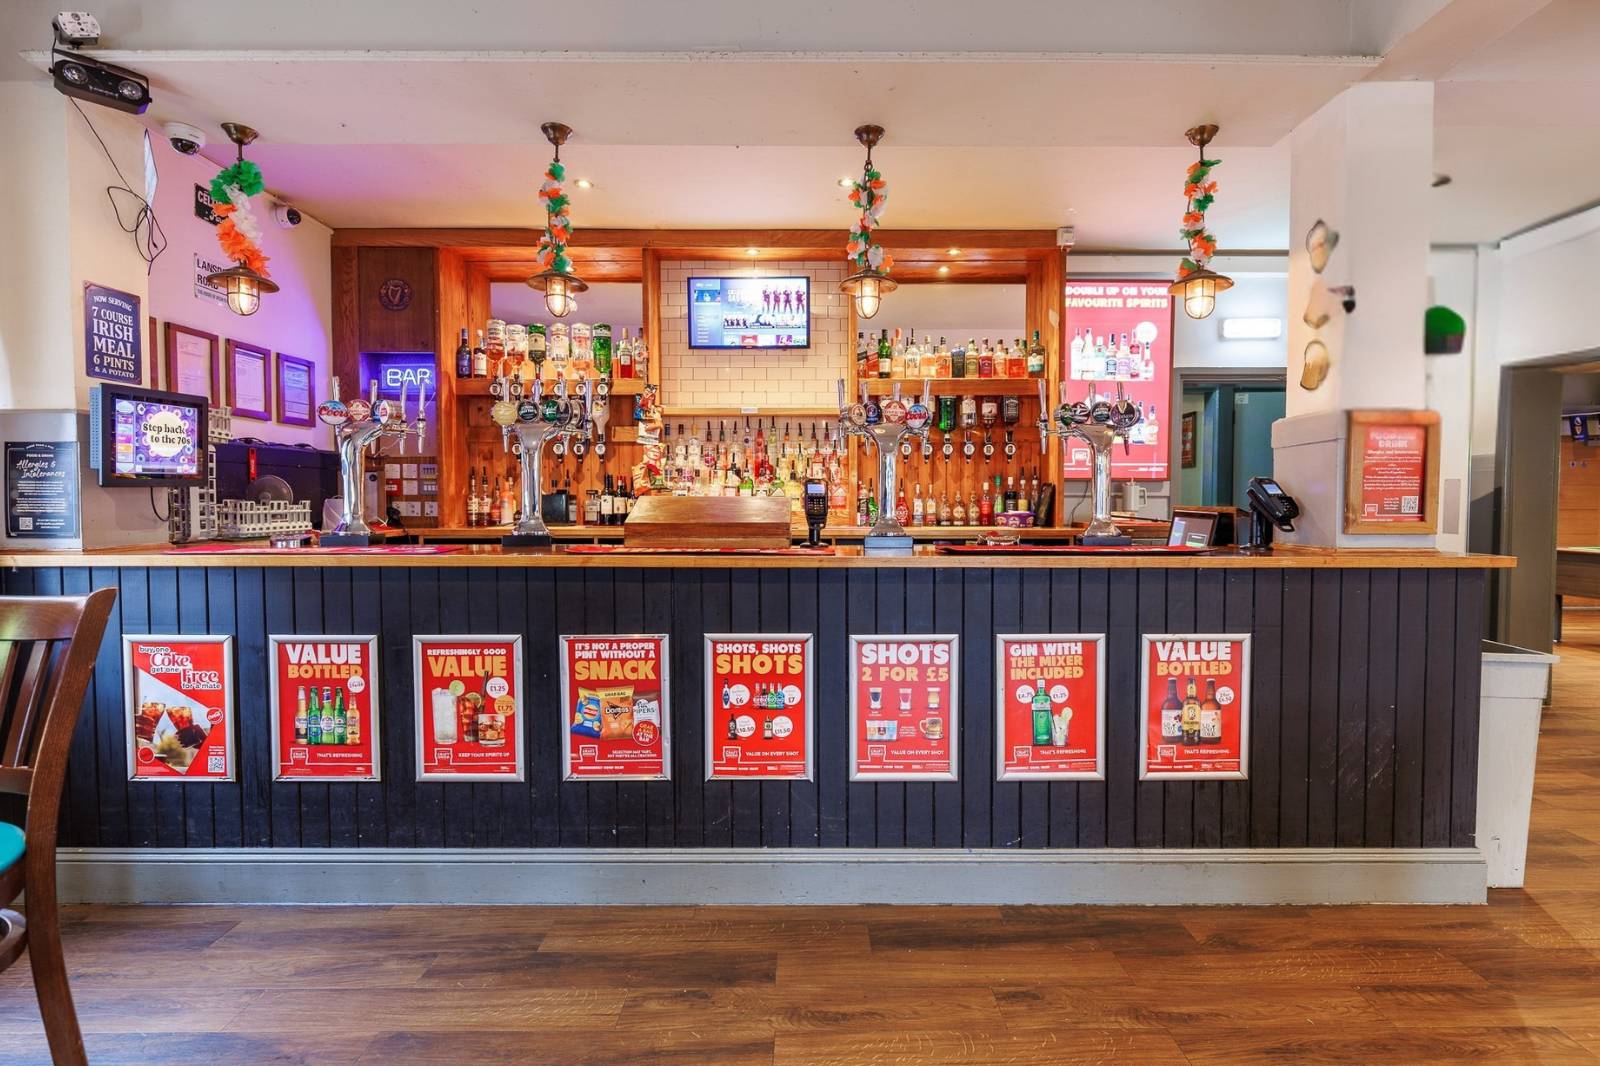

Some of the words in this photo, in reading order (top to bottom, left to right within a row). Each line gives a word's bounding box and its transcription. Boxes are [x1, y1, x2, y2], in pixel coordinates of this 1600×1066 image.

[1065, 286, 1104, 296] DOUBLE
[1105, 286, 1120, 295] UP
[1122, 286, 1138, 295] ON
[1140, 286, 1168, 296] YOUR
[93, 295, 107, 303] NOW
[108, 296, 133, 312] SERVING
[1065, 298, 1123, 308] FAVOURITE
[1126, 298, 1168, 308] SPIRITS
[92, 306, 98, 317] 7
[101, 308, 134, 326] COURSE
[92, 318, 134, 342] IRISH
[93, 335, 135, 359] MEAL
[93, 354, 100, 365] 6
[103, 355, 135, 371] PINTS
[108, 368, 135, 378] POTATO
[387, 368, 432, 386] BAR
[143, 423, 162, 433] Step
[164, 424, 185, 434] back
[150, 434, 160, 443] to
[161, 434, 175, 444] the
[139, 646, 155, 655] buy
[285, 644, 361, 664] VALUE
[575, 651, 597, 659] PINT
[599, 651, 646, 659] WITHOUT
[716, 643, 759, 654] SHOTS,
[762, 643, 802, 653] SHOTS
[861, 644, 949, 665] SHOTS
[1010, 644, 1037, 656] GIN
[1043, 642, 1082, 655] WITH
[1155, 641, 1231, 661] VALUE
[151, 653, 189, 667] Coke
[428, 656, 507, 677] VALUE
[716, 654, 803, 675] SHOTS
[1010, 657, 1035, 668] THE
[1039, 655, 1084, 667] MIXER
[182, 668, 217, 683] Free
[288, 665, 363, 678] BOTTLED
[575, 660, 656, 680] SNACK
[862, 667, 872, 681] 2
[880, 667, 919, 681] FOR
[926, 667, 949, 682] £5
[1010, 667, 1085, 680] INCLUDED
[1157, 661, 1232, 676] BOTTLED
